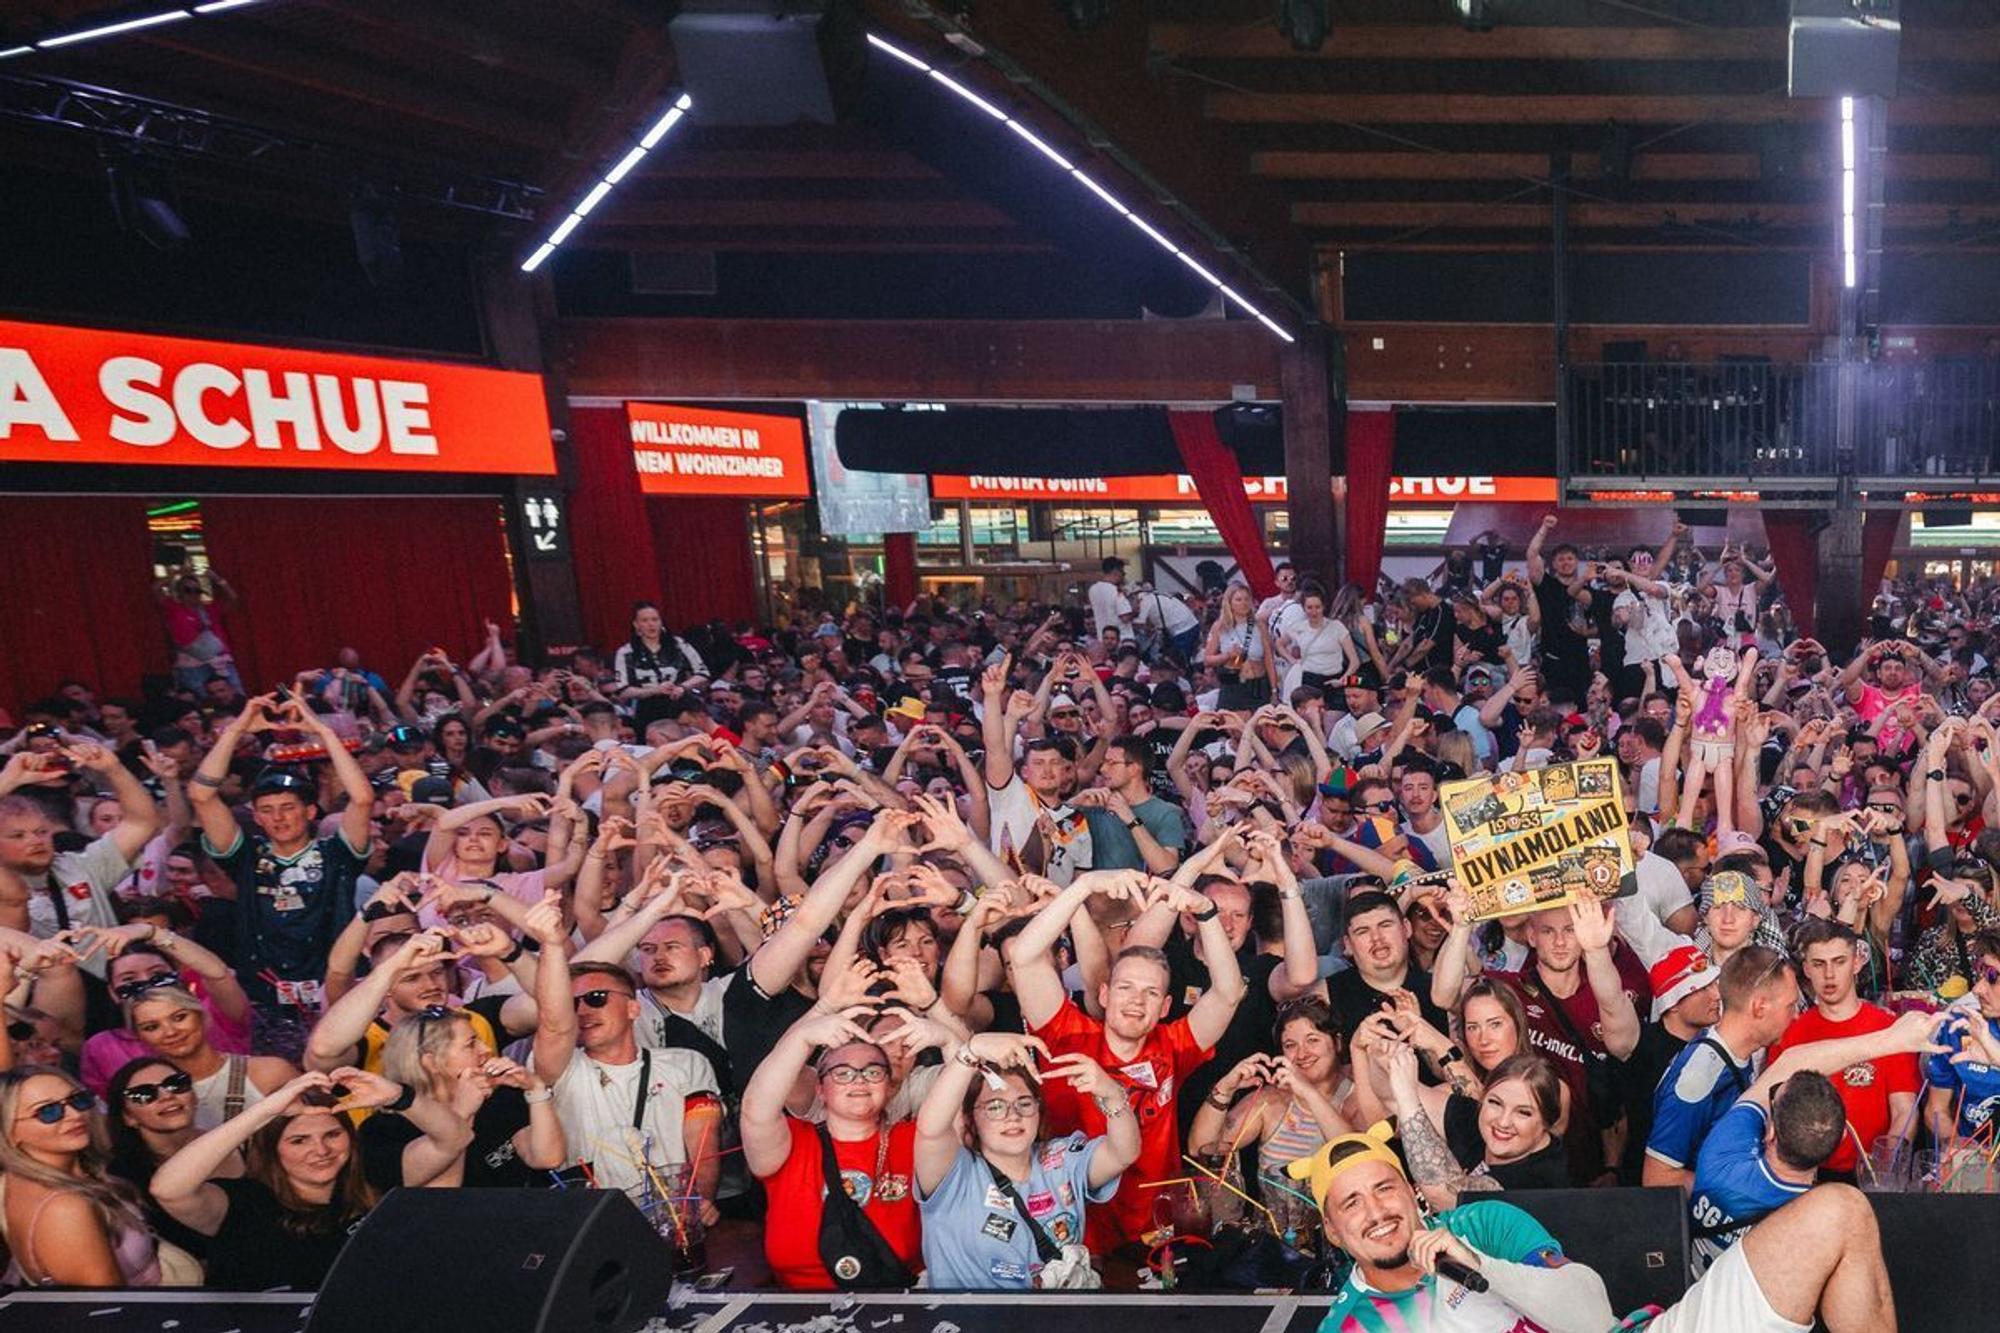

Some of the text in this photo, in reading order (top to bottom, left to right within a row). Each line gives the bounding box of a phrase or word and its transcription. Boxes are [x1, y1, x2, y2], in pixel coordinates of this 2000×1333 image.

[98, 356, 439, 456] SCHUE
[631, 420, 760, 450] WILLKOMMEN IN
[674, 452, 784, 478] WOHNZIMMER
[1461, 801, 1623, 888] DYNAMOLAND
[1693, 1194, 1721, 1228] SG
